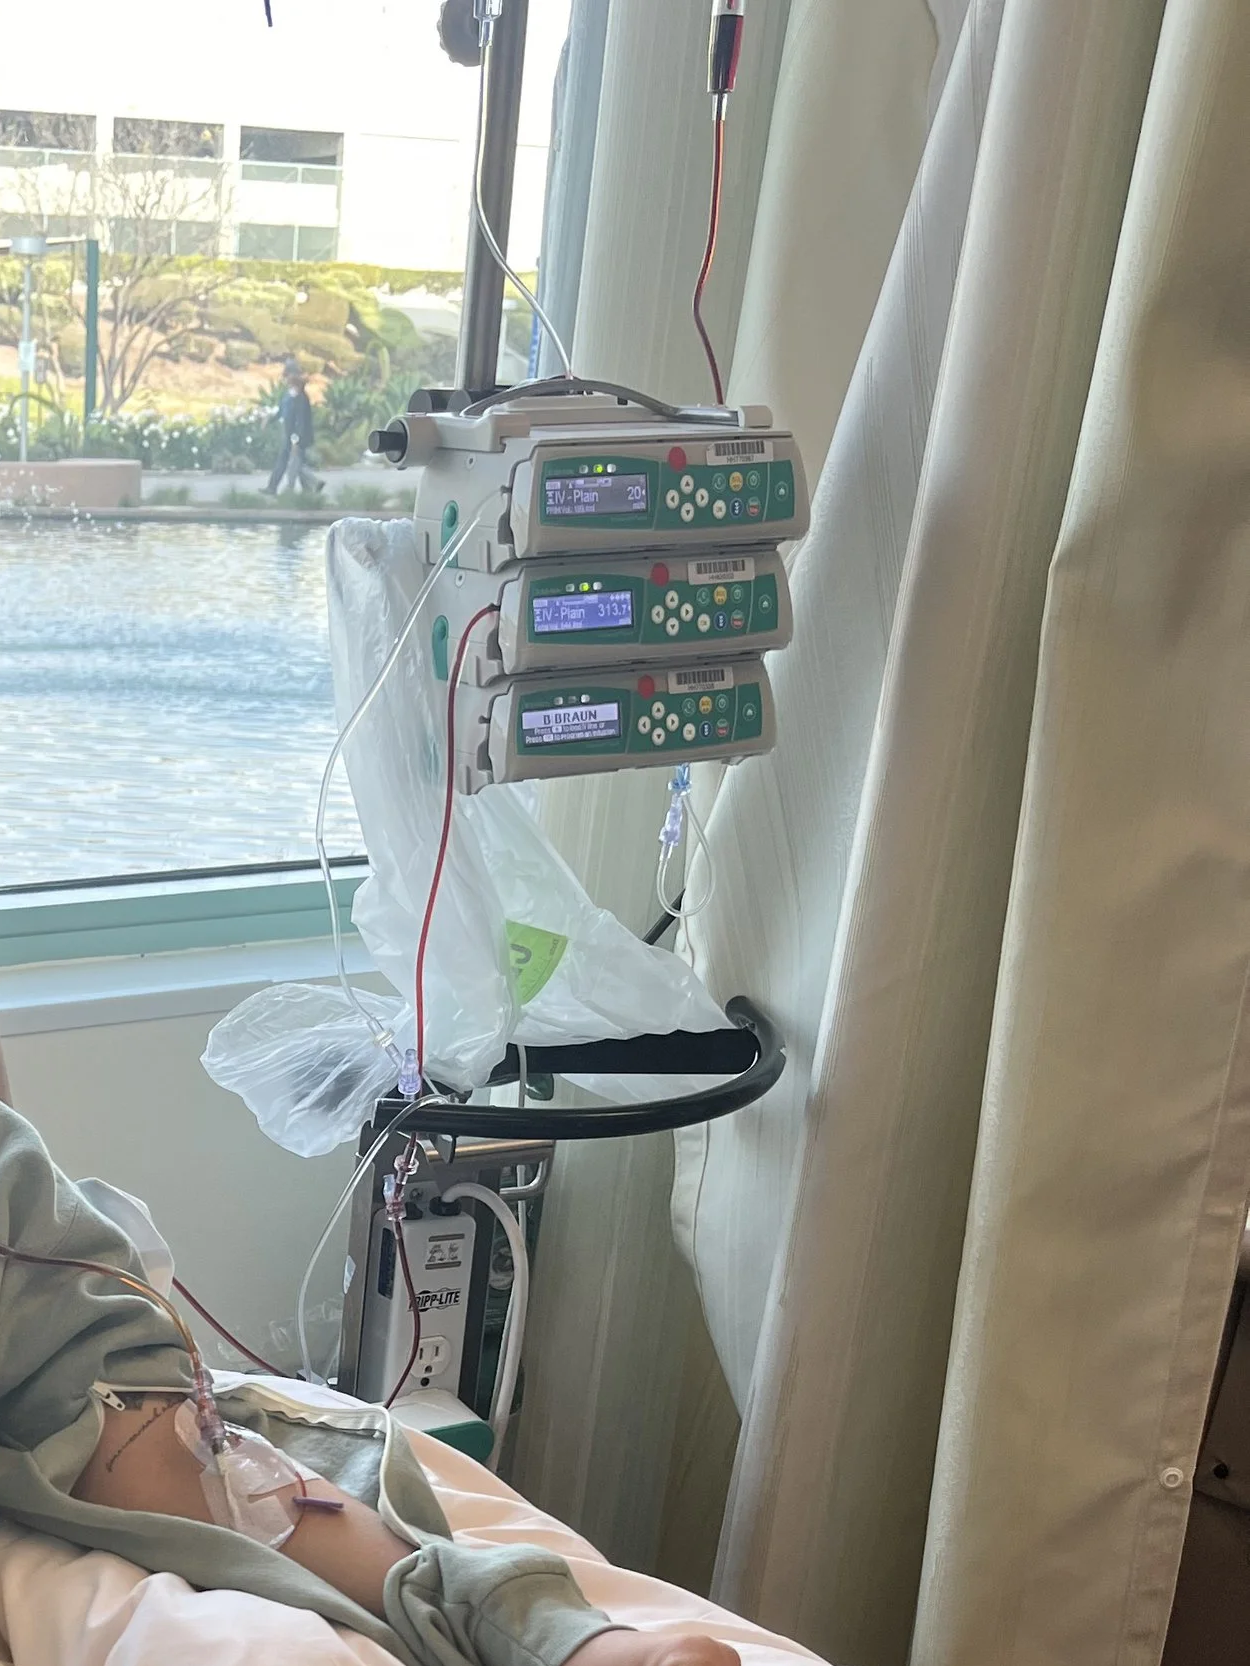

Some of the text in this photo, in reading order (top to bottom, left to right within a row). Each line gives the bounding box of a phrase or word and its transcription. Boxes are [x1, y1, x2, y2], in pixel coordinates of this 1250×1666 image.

[573, 488, 599, 503] Plain
[626, 485, 642, 501] 20
[560, 605, 586, 620] Plain
[554, 709, 598, 724] BRAUN
[409, 1291, 461, 1310] RIPP-LITE
